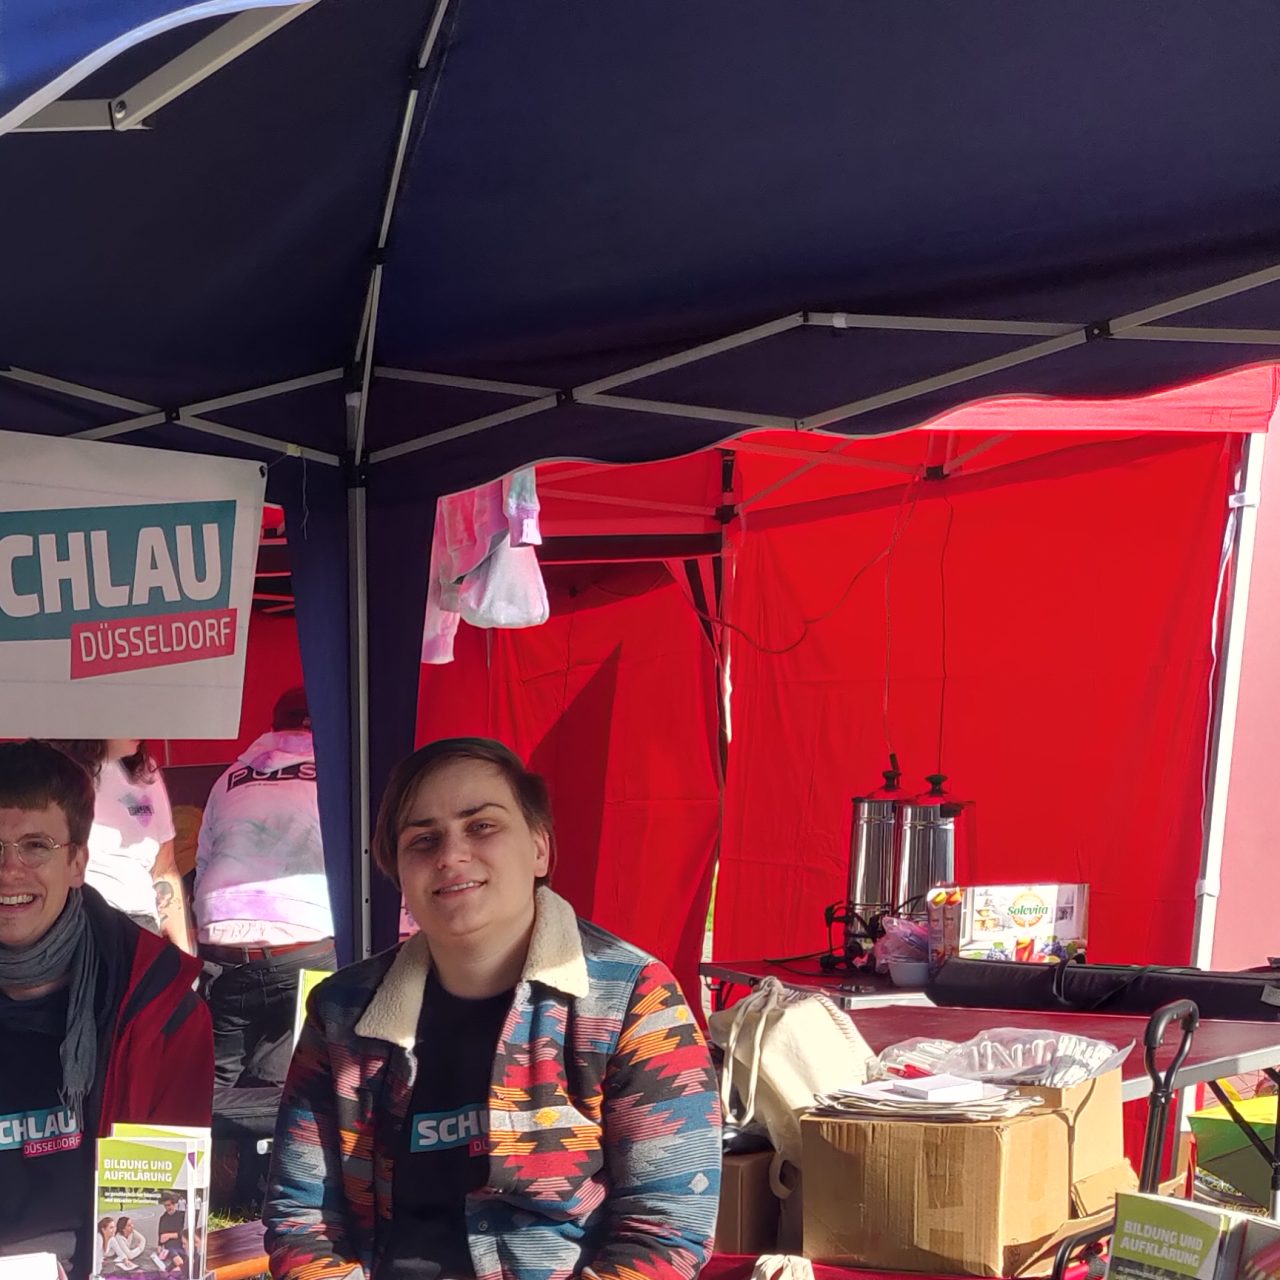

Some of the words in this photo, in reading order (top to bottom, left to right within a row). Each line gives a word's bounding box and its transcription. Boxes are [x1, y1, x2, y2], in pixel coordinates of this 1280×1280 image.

[79, 616, 231, 663] DÜSSELDORF
[1007, 904, 1049, 916] Solevita
[24, 1136, 81, 1155] DÜSSELDORF
[103, 1159, 149, 1170] BILDUNG
[151, 1161, 173, 1171] UND
[103, 1170, 173, 1182] AUFKLÄRUNG
[1123, 1220, 1178, 1243] BILDUNG
[1180, 1233, 1204, 1251] UND
[1120, 1236, 1200, 1268] AUFKLÄRUNG
